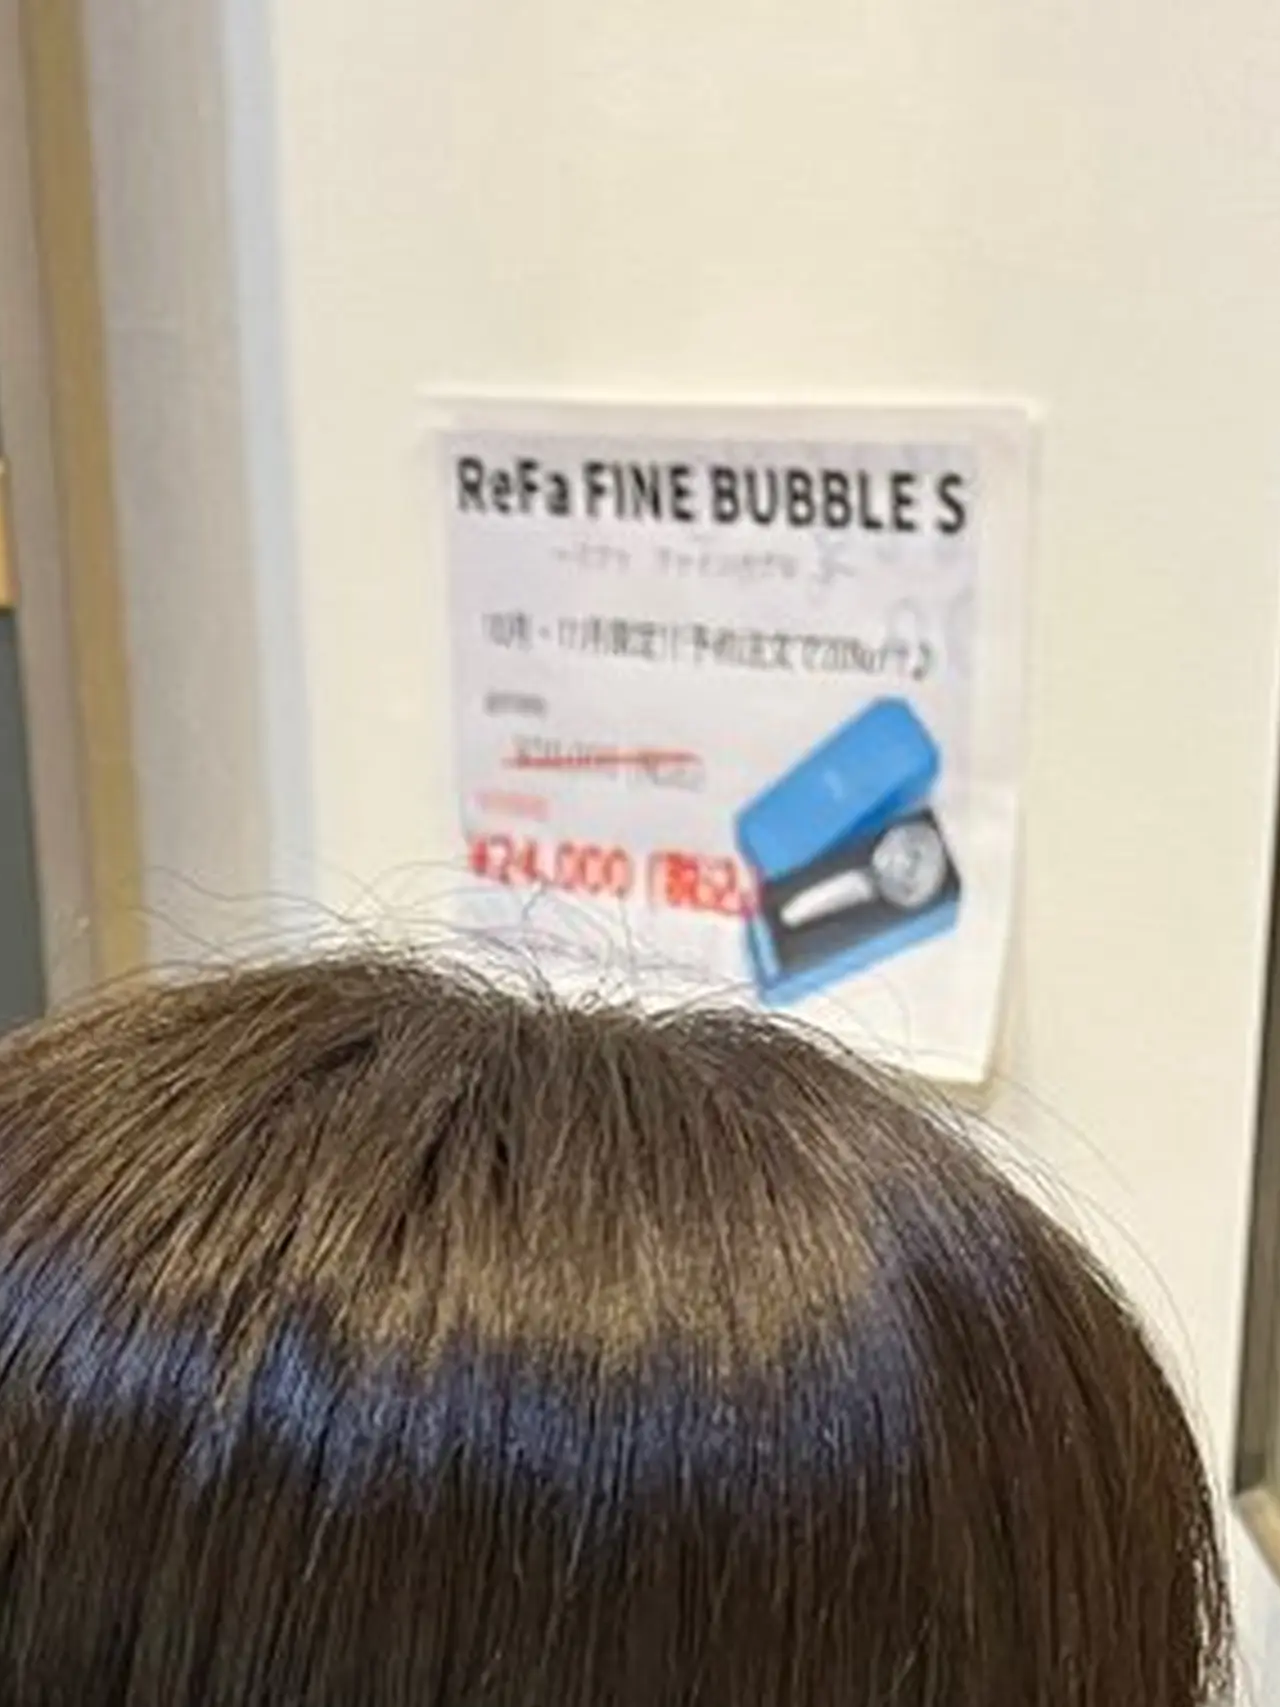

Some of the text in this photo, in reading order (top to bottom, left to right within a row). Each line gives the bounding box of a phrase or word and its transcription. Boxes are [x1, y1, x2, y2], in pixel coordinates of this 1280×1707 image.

[455, 455, 968, 535] ReFa FINE BUBBLE S
